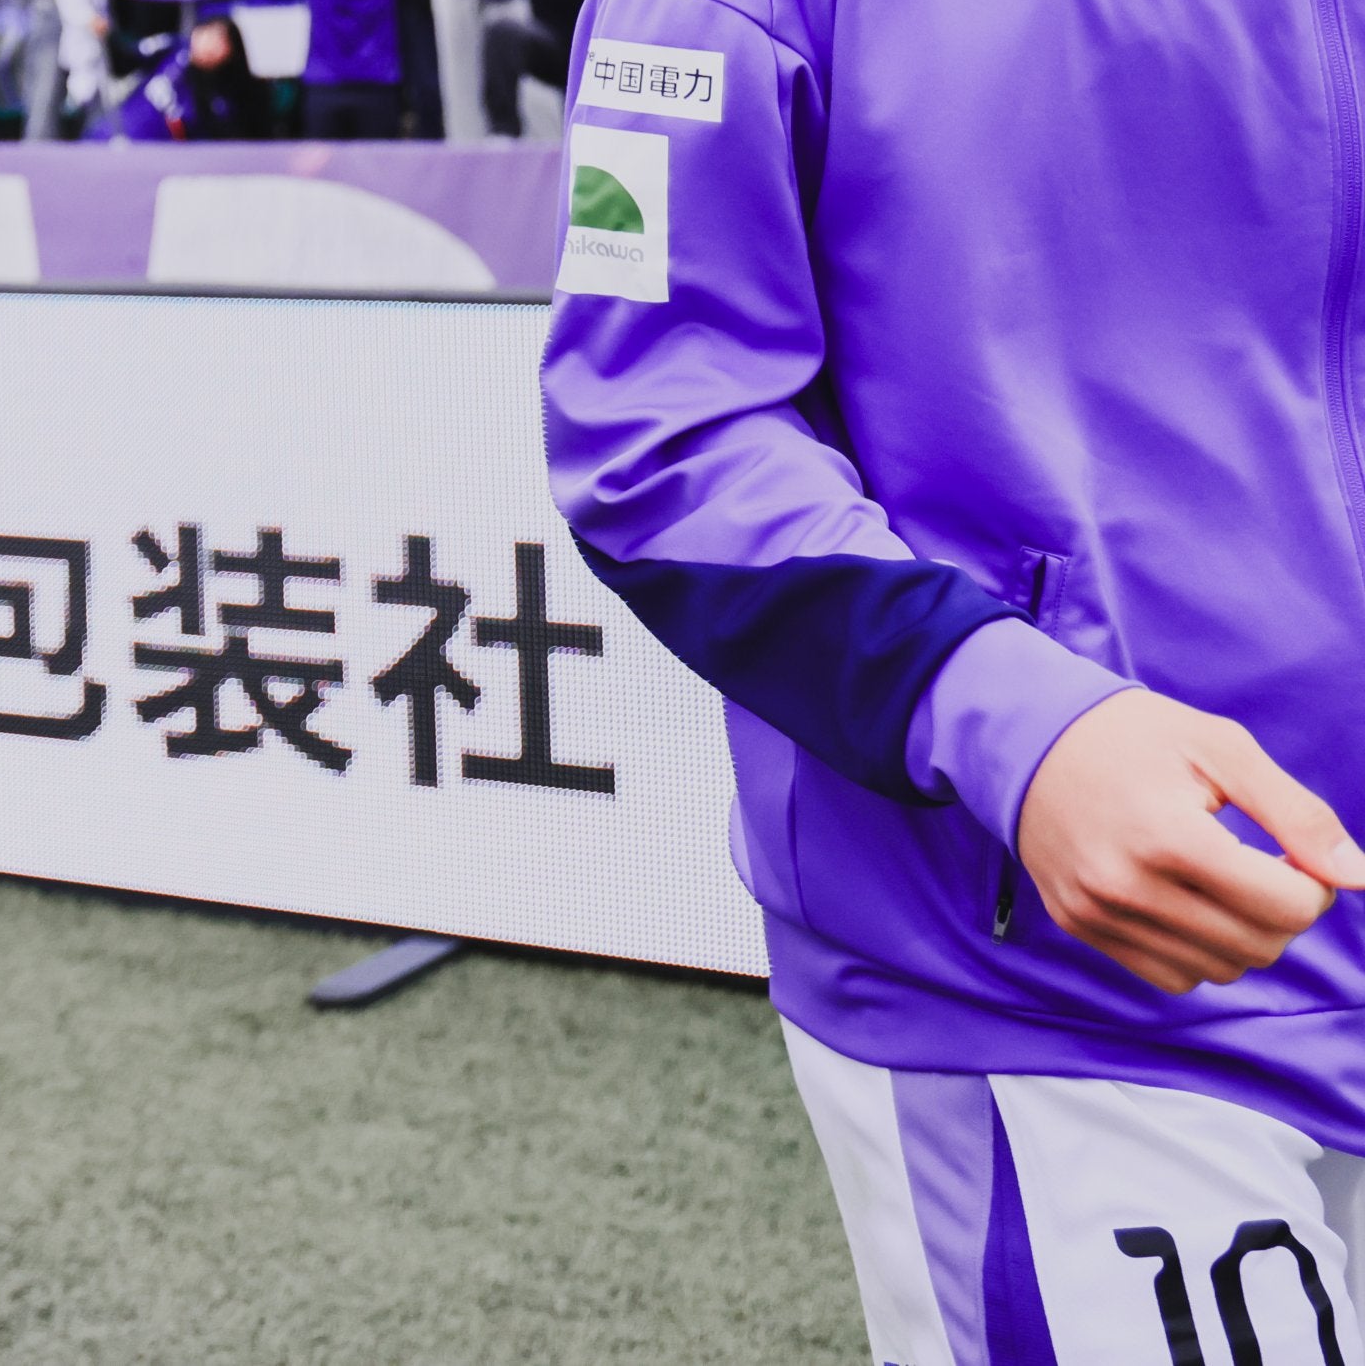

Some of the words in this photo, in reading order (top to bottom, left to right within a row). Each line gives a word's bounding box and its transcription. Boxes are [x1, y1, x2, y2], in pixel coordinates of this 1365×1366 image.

[594, 57, 713, 102] 中国電力
[1113, 1218, 1345, 1366] 10
